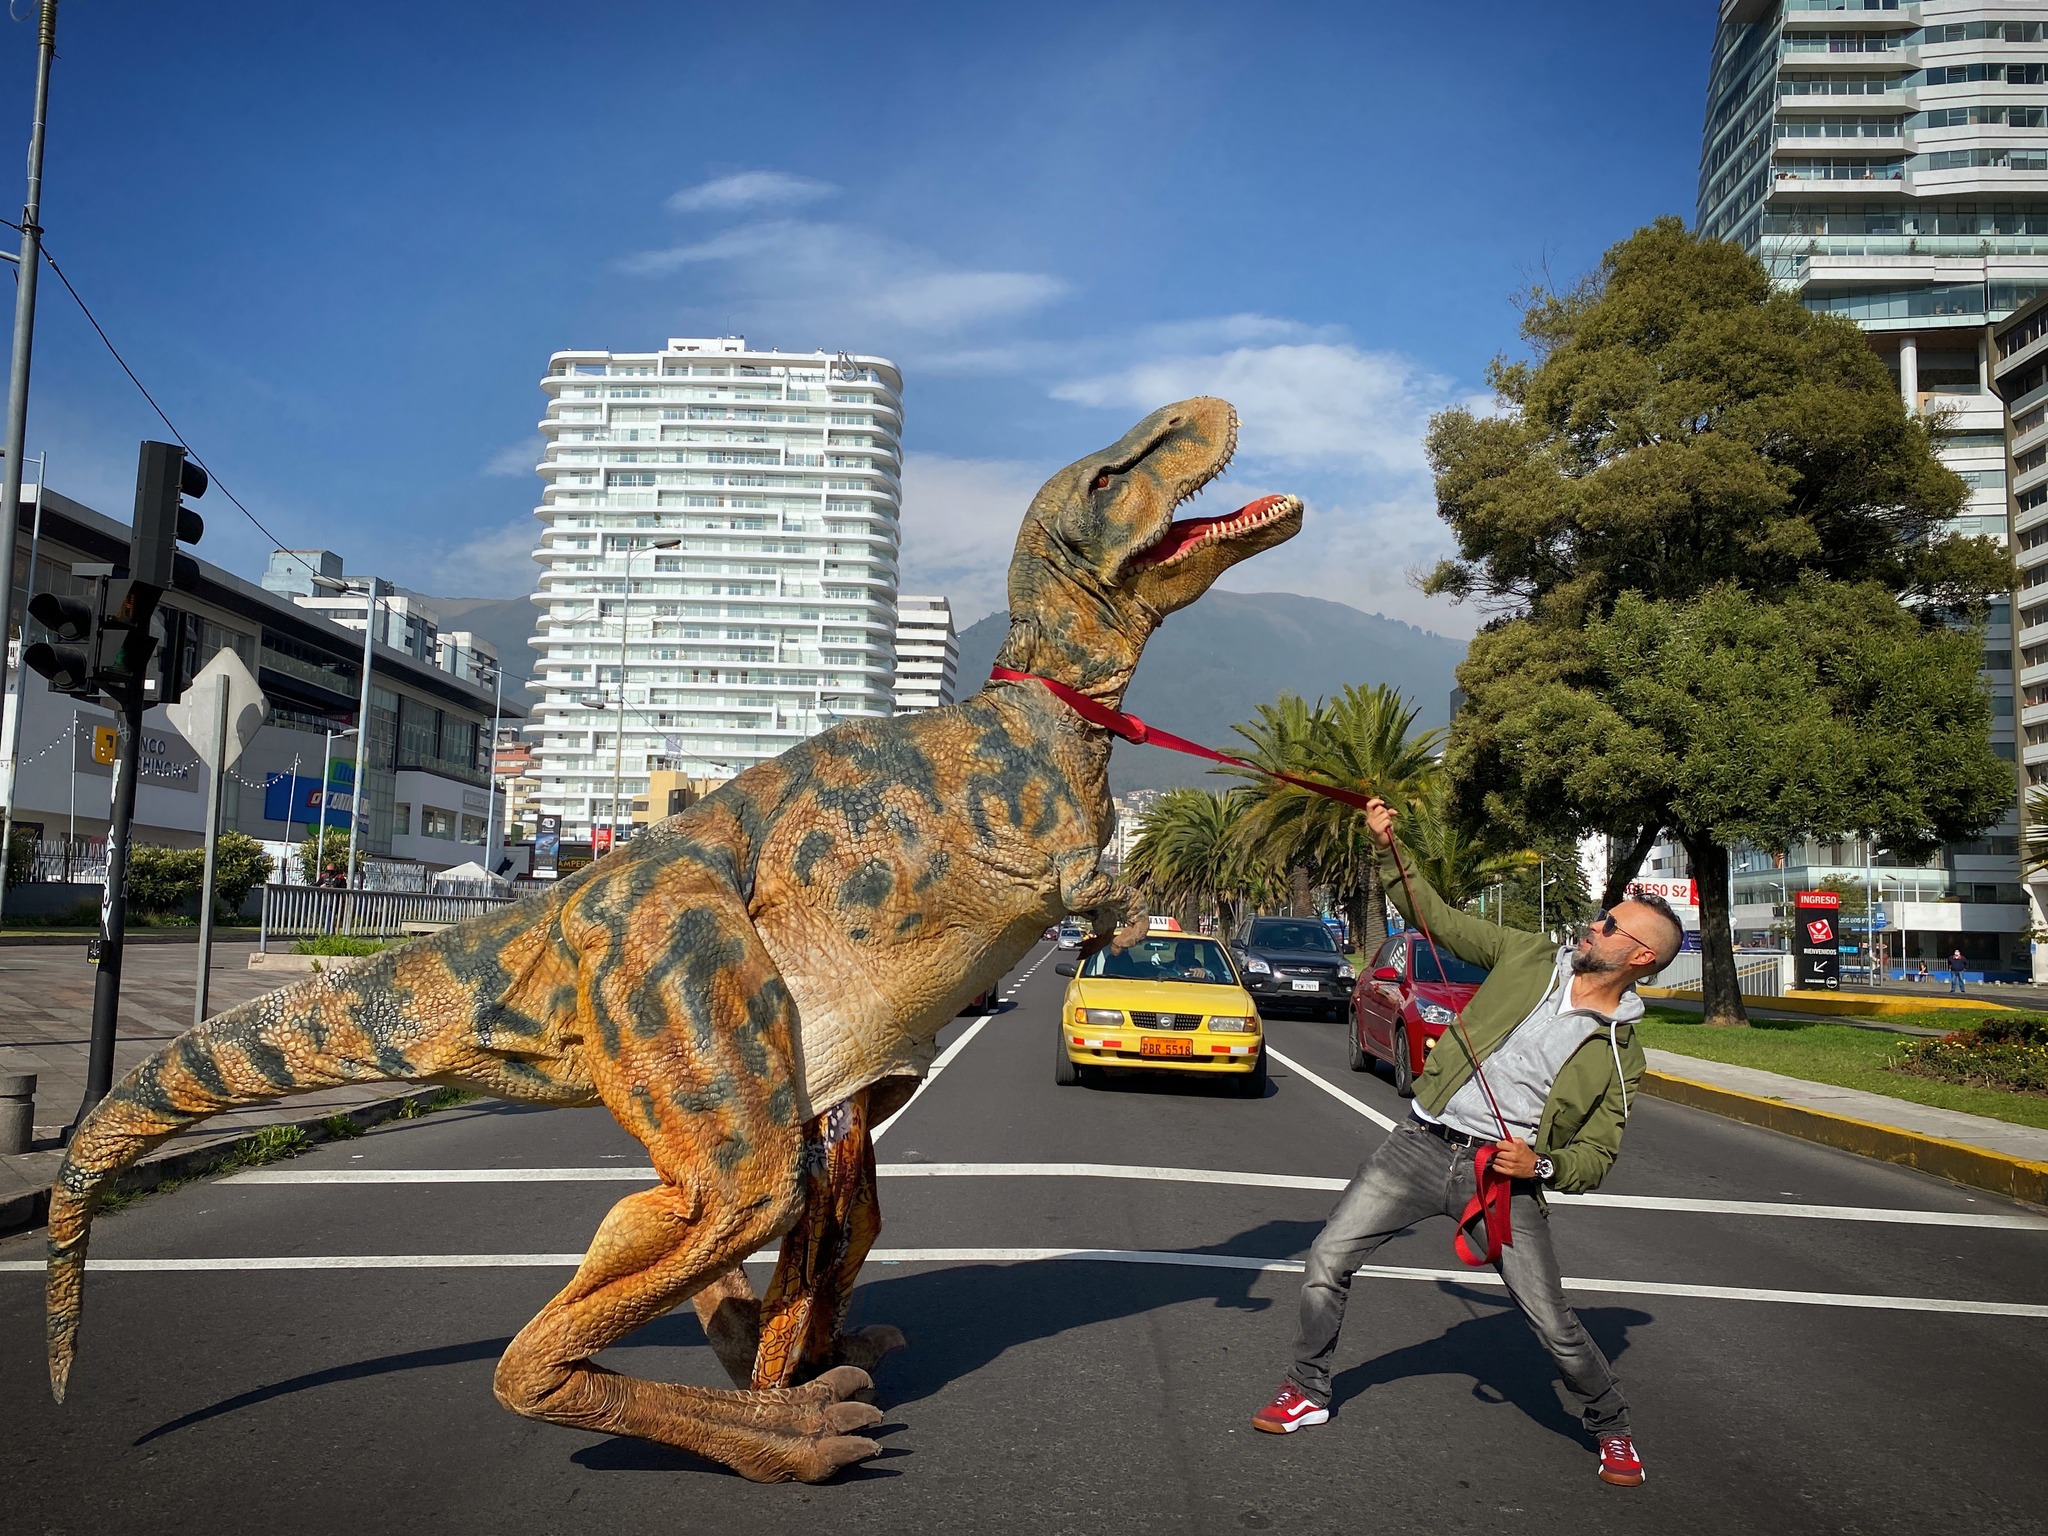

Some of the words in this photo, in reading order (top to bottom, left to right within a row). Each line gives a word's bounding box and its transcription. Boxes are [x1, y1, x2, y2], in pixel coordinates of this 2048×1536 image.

[140, 736, 166, 755] NCO
[141, 757, 189, 779] HINCHA
[1672, 885, 1687, 898] S2
[1801, 895, 1837, 905] INGRESO
[1142, 1043, 1191, 1056] PBR-5518
